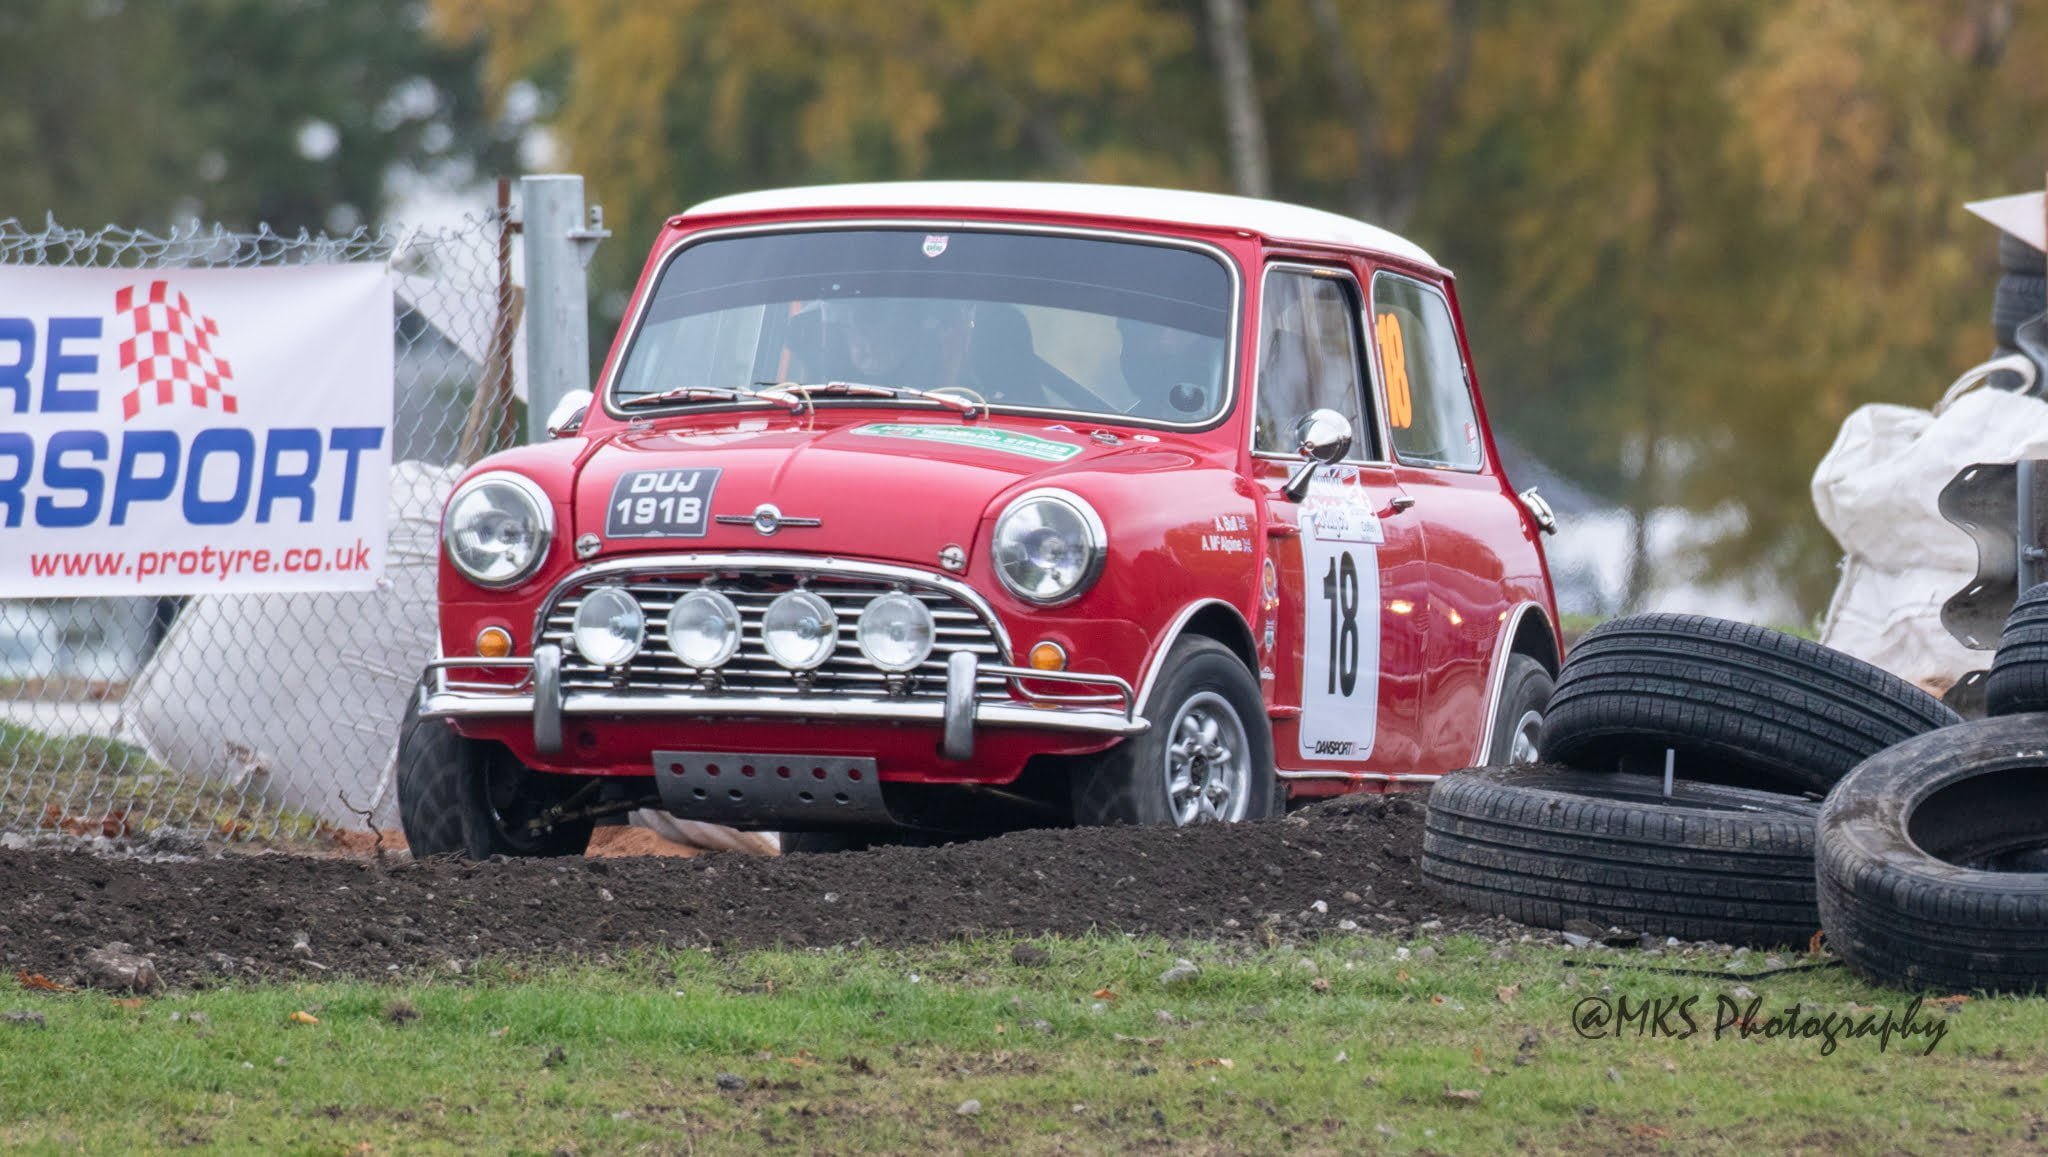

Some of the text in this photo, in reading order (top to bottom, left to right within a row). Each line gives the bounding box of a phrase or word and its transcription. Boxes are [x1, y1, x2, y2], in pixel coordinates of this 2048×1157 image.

[1377, 313, 1412, 429] 18
[630, 471, 701, 494] DUJ
[616, 497, 702, 525] 191B
[31, 538, 371, 583] www.protyre.co.uk
[1323, 551, 1359, 698] 18
